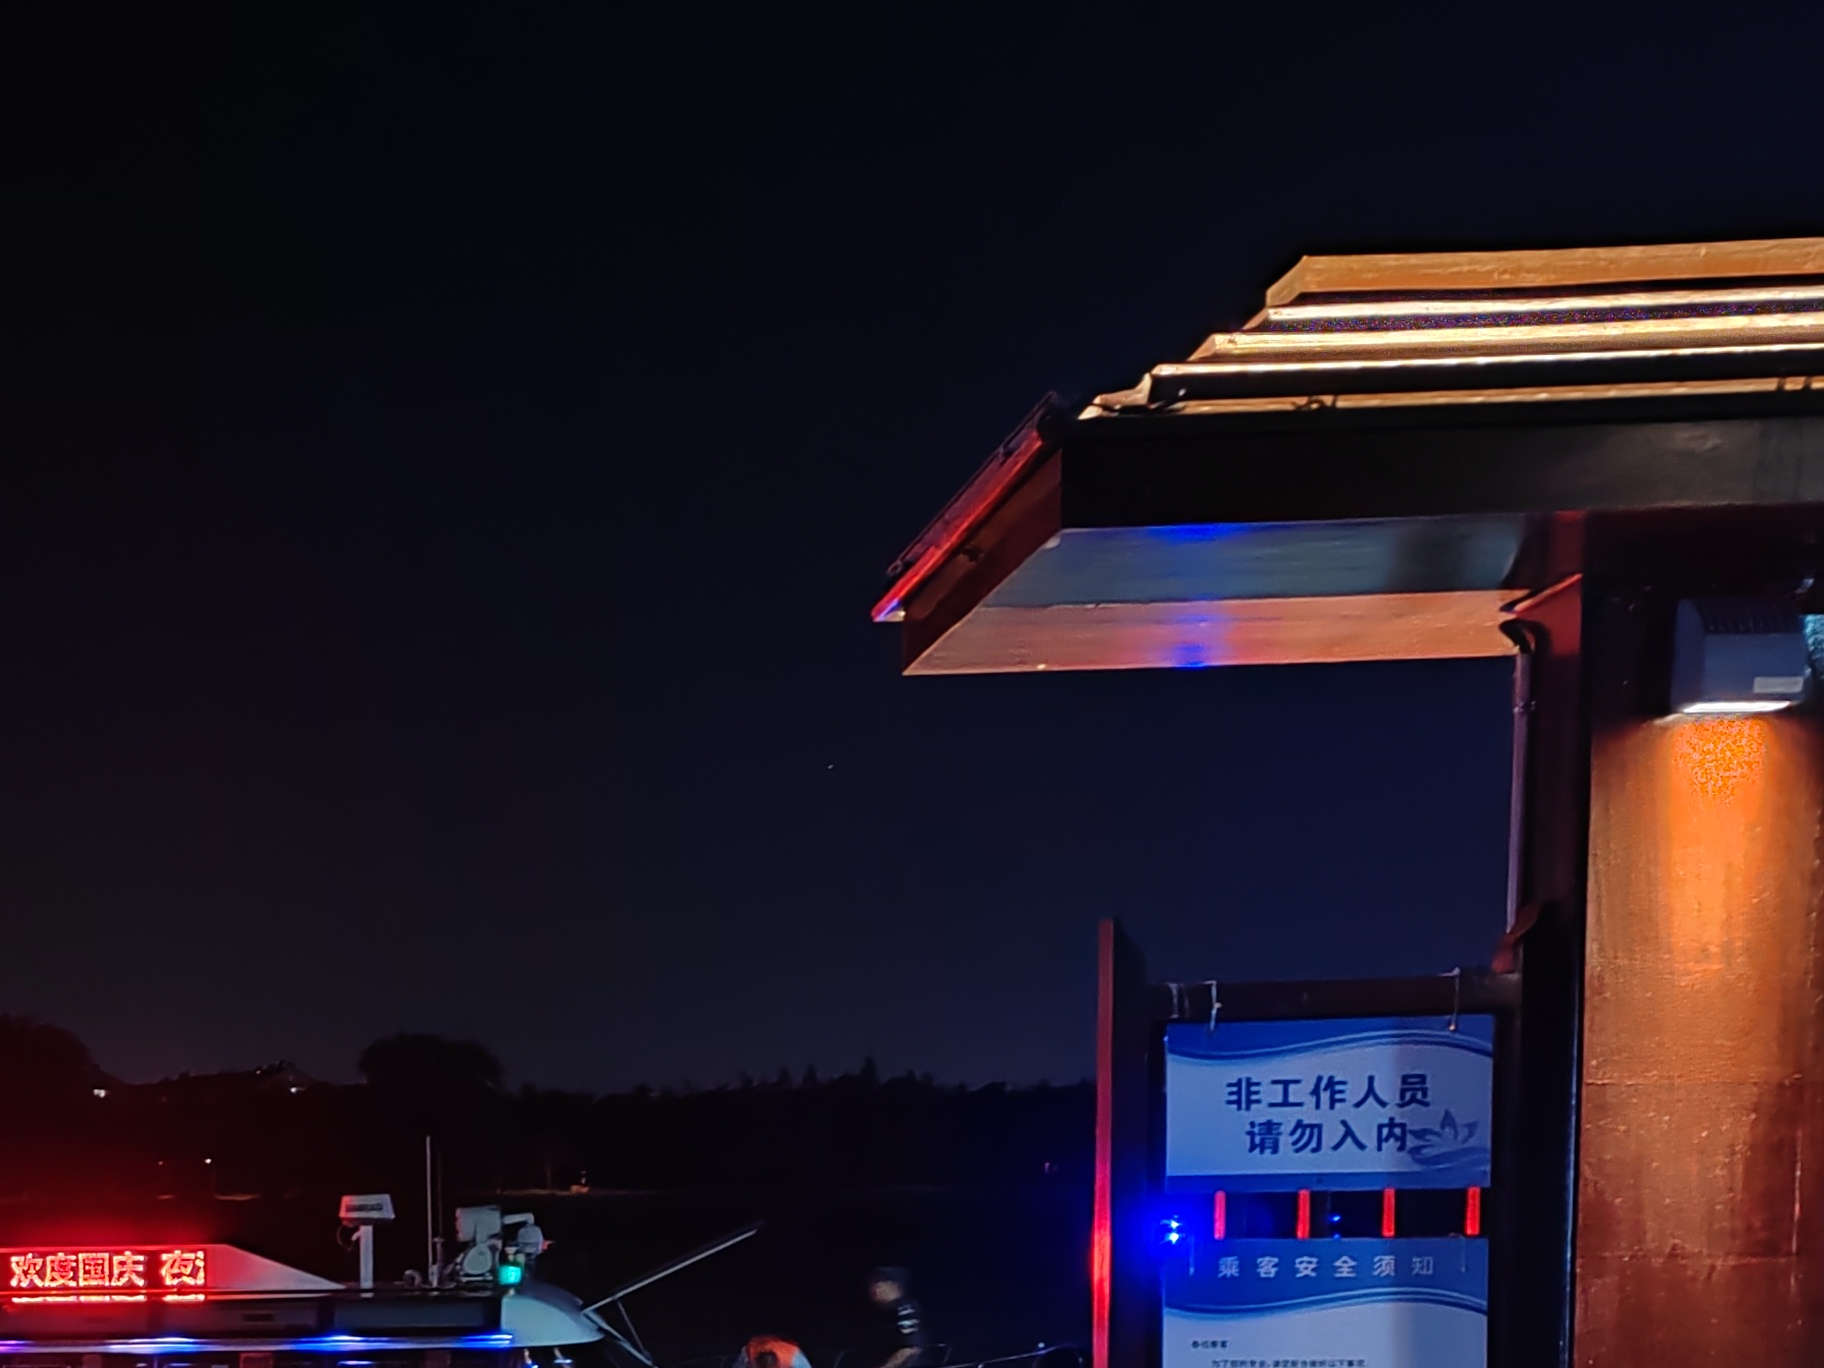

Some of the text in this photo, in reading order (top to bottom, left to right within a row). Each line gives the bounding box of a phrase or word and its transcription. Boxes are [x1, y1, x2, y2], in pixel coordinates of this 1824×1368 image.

[1225, 1073, 1431, 1112] 非工作人员
[1245, 1117, 1408, 1155] 请勿入内
[10, 1251, 145, 1288] 欢度国庆
[1217, 1256, 1434, 1279] 乘客安全须知
